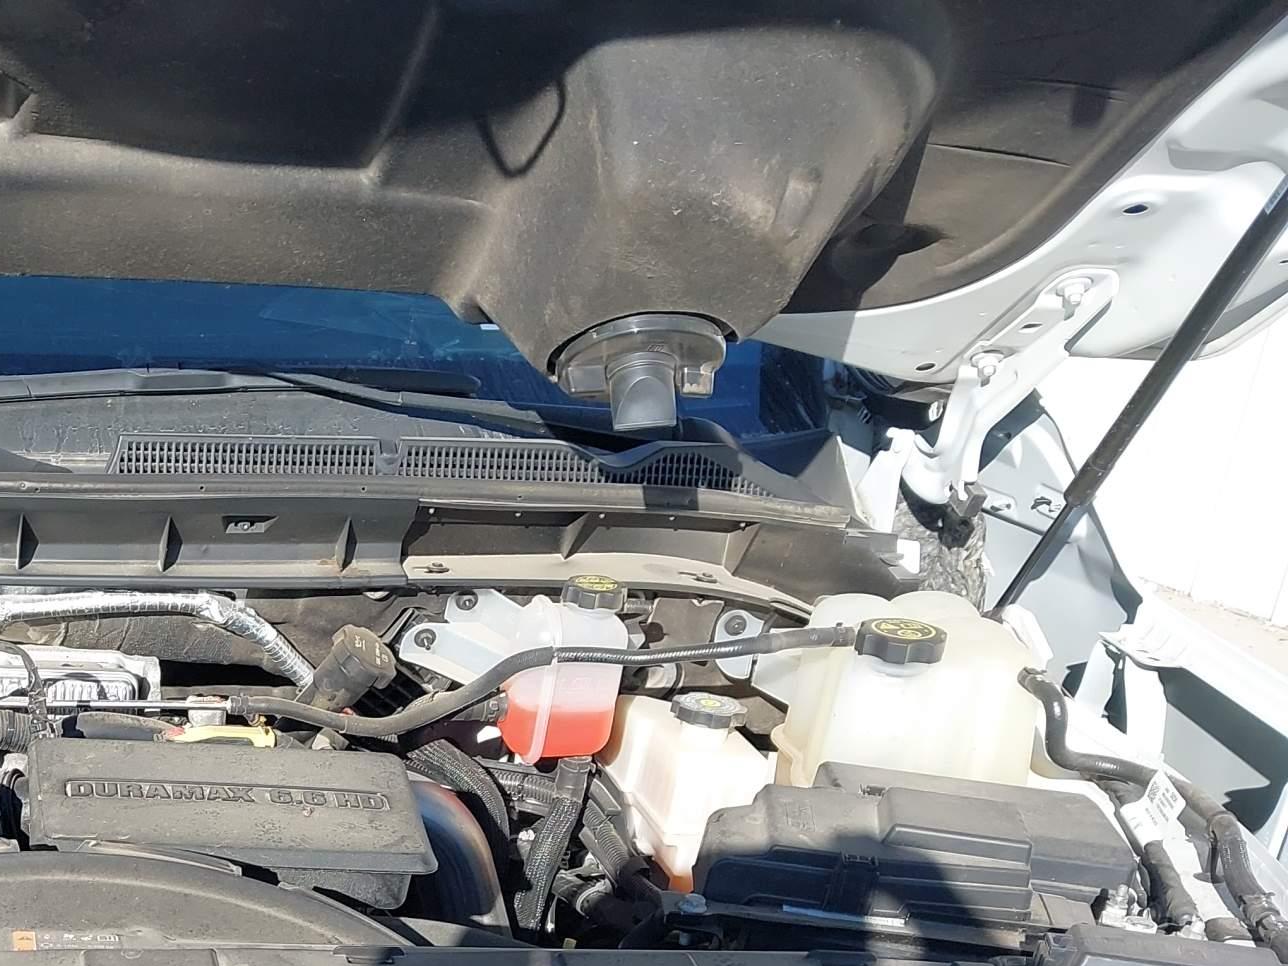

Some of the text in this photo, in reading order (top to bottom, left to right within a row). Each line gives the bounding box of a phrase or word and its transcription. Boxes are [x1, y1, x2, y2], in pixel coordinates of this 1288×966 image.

[69, 781, 389, 811] DURAMAX 6.6 HD
